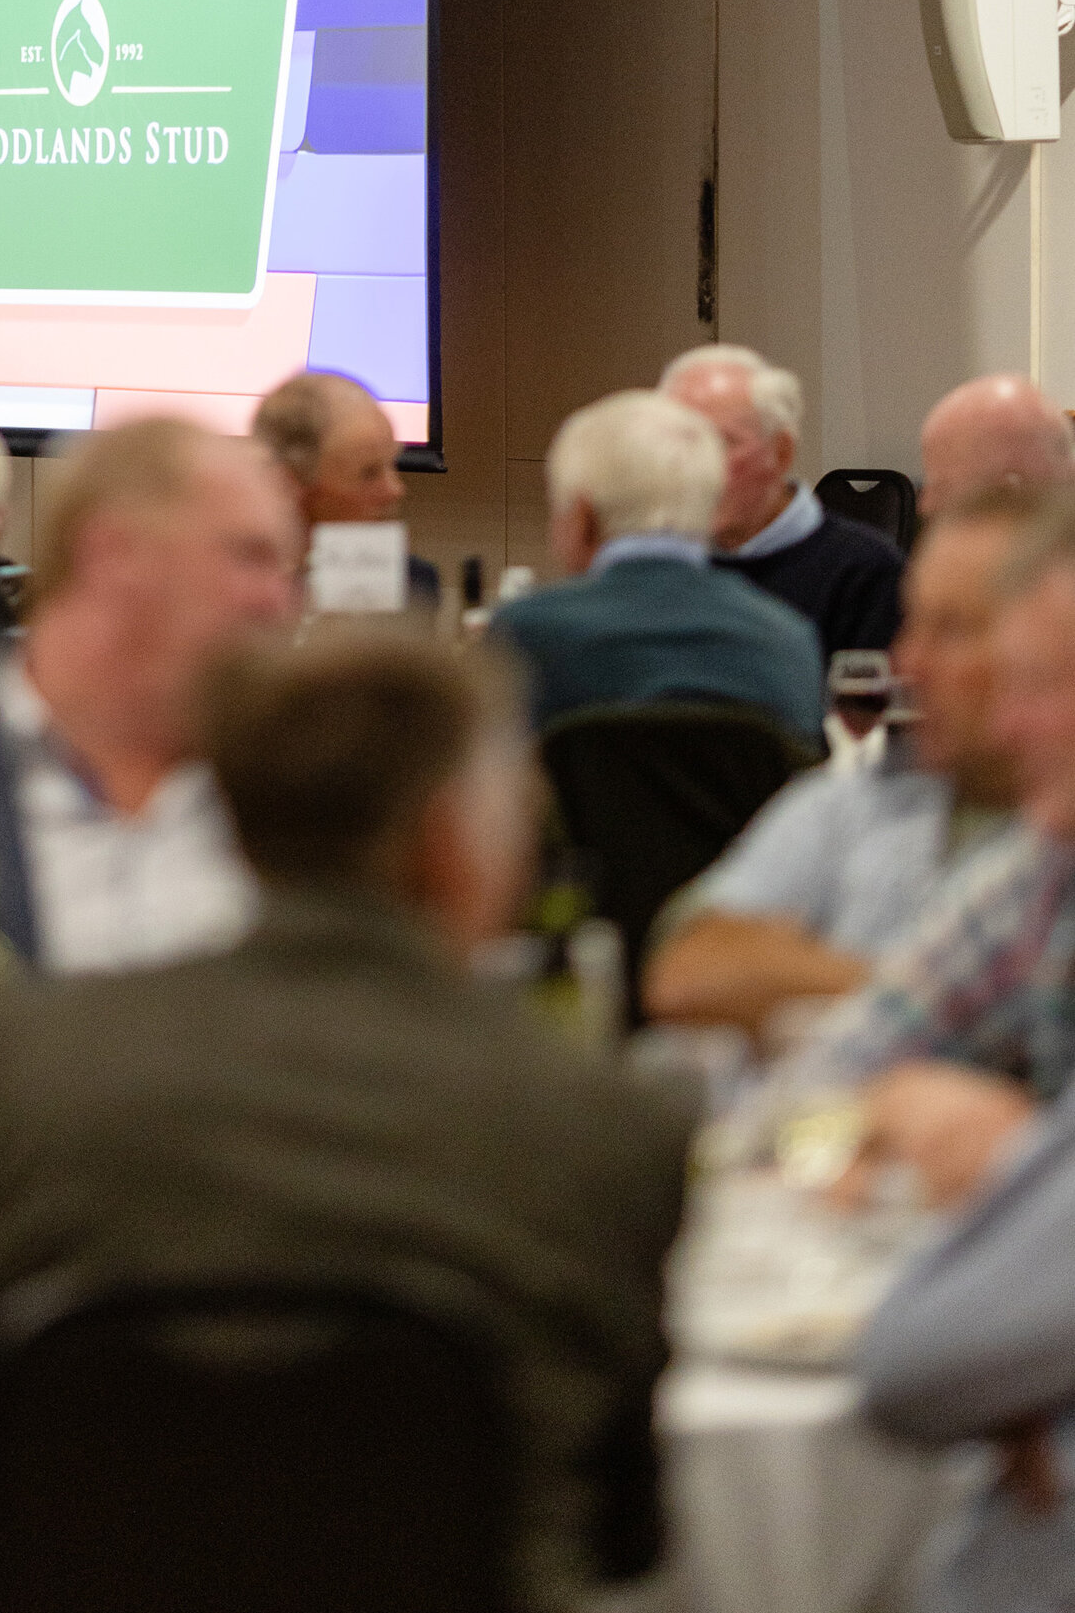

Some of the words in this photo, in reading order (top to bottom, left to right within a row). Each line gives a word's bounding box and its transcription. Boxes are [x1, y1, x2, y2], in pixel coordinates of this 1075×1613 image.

[20, 45, 45, 63] EST.
[114, 43, 144, 61] 1992
[145, 121, 229, 165] STUD
